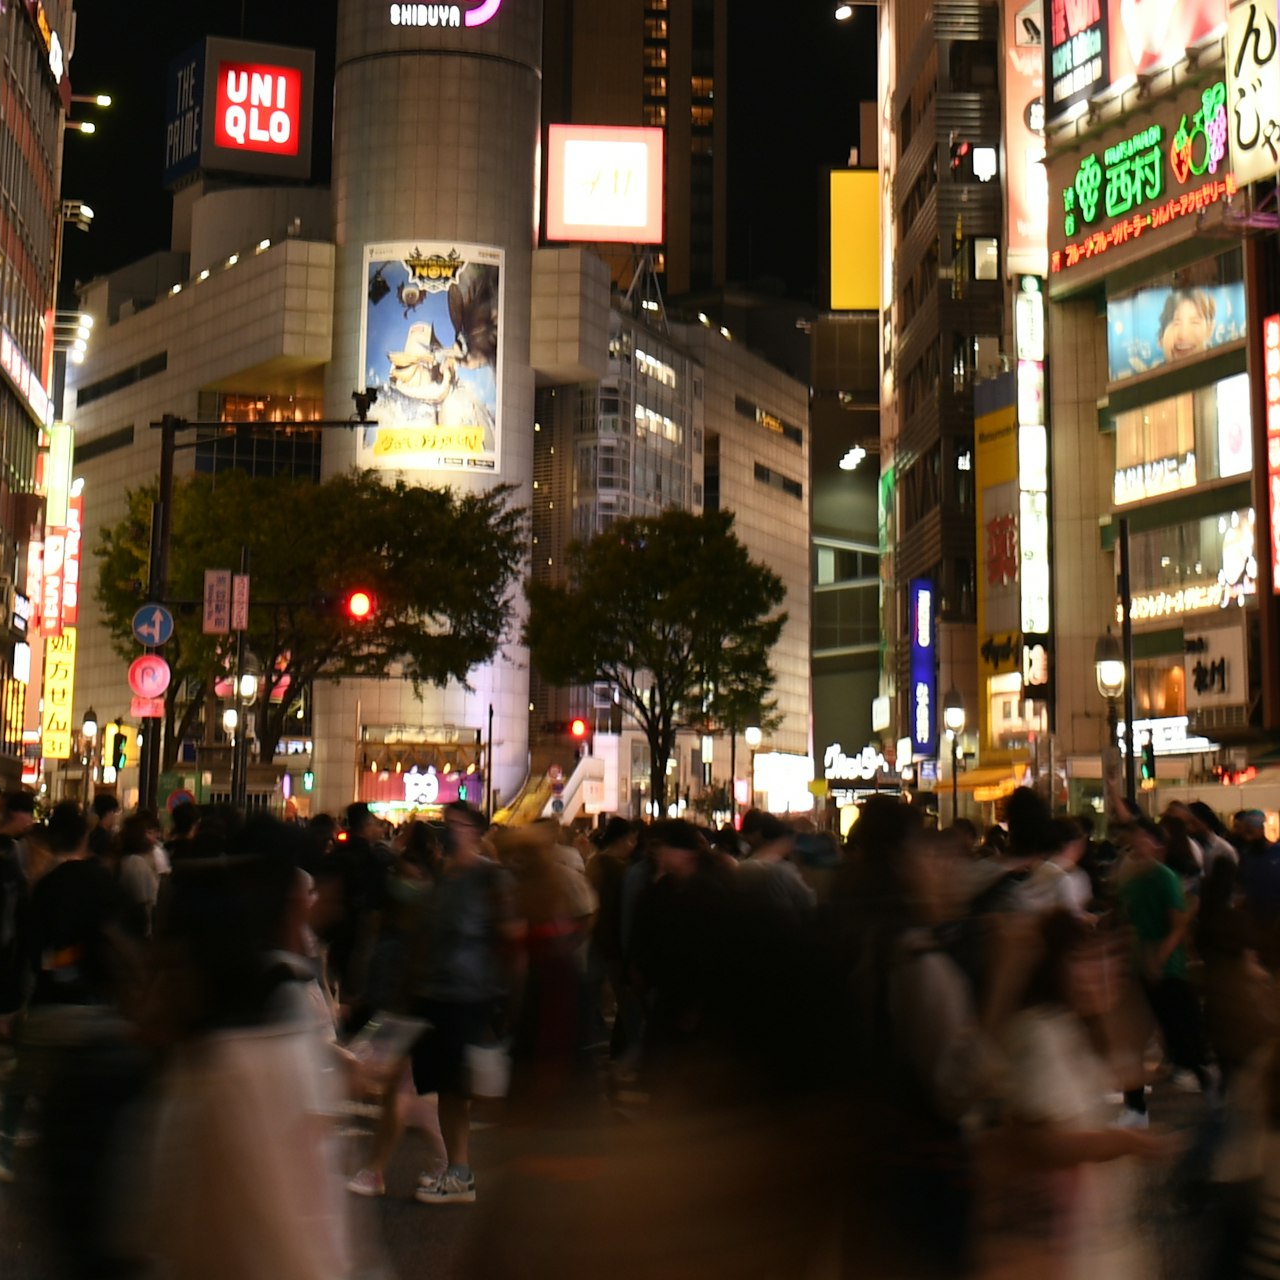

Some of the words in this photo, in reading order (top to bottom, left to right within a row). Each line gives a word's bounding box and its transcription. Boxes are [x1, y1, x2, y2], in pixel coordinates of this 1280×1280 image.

[390, 3, 461, 28] SHIBUYA
[176, 61, 196, 103] THE
[226, 69, 287, 107] UNI
[166, 105, 200, 171] PRIME
[224, 110, 291, 145] QLO
[1105, 145, 1161, 218] 西村
[416, 266, 454, 279] NOW
[46, 633, 73, 731] 処方せん
